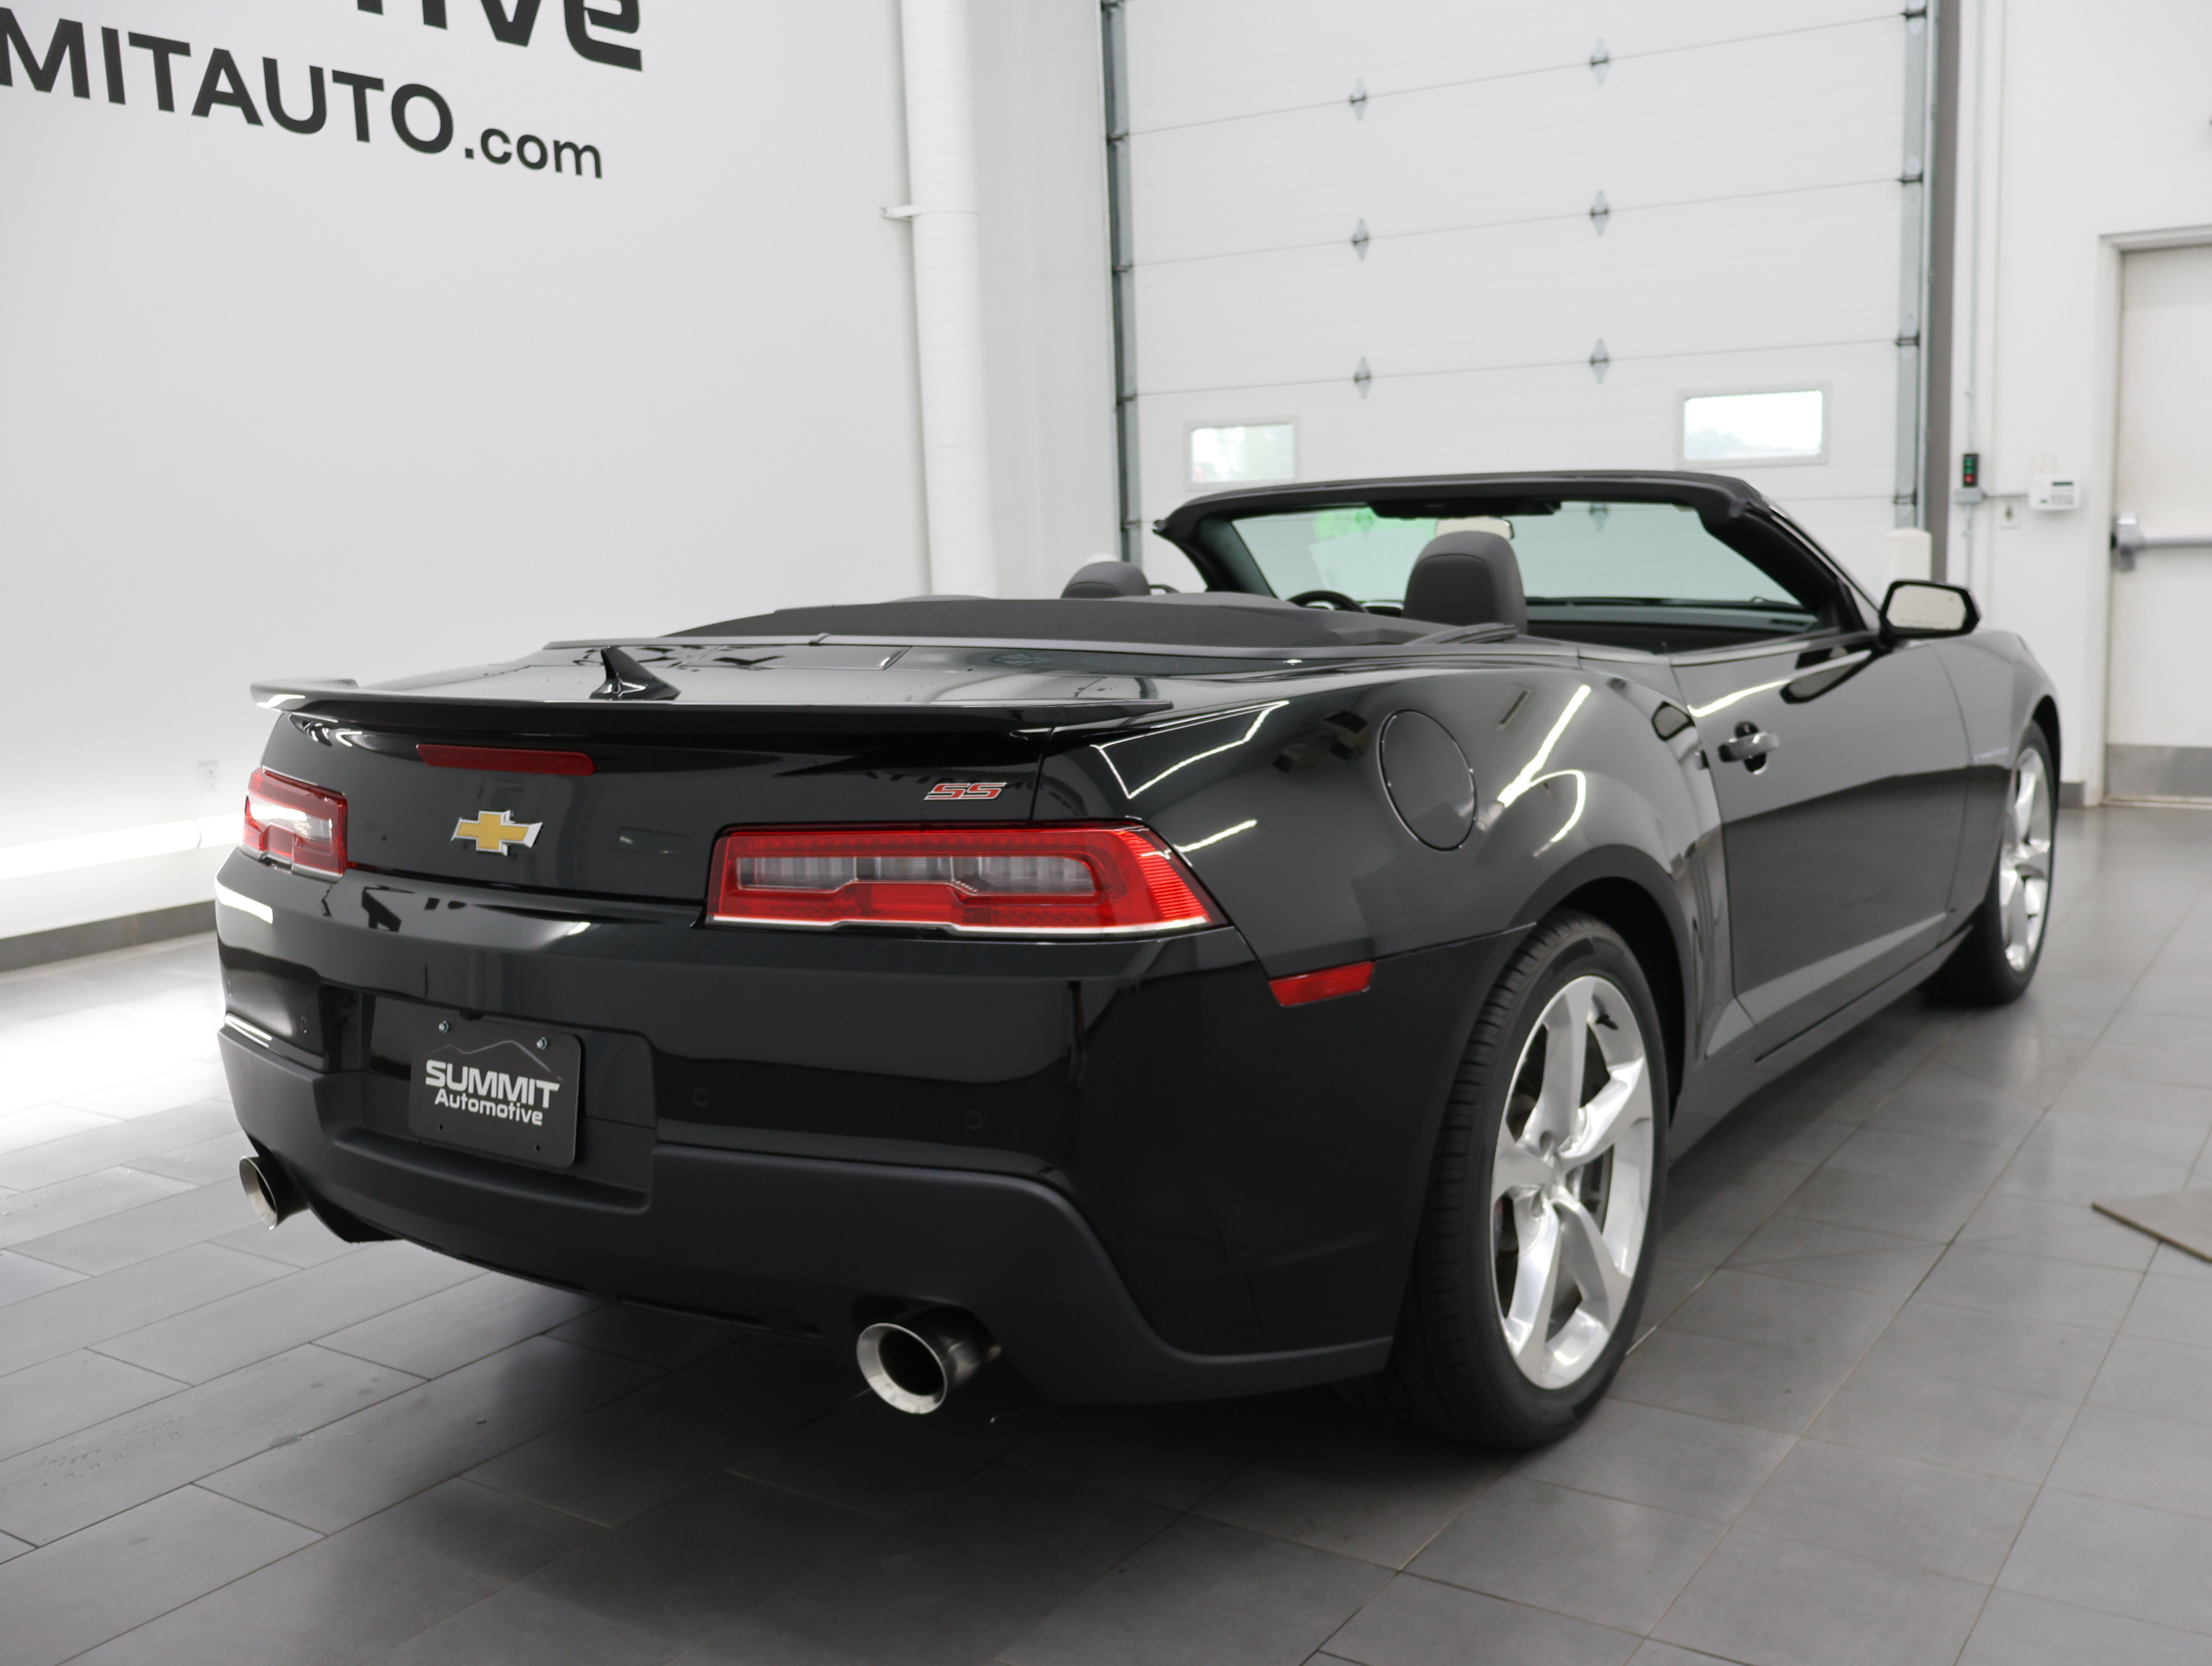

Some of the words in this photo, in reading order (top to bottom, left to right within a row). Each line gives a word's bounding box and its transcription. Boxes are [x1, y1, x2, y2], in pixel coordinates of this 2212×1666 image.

[922, 782, 1007, 800] SS
[425, 1059, 560, 1108] SUMMIT
[434, 1088, 543, 1126] Automotive
